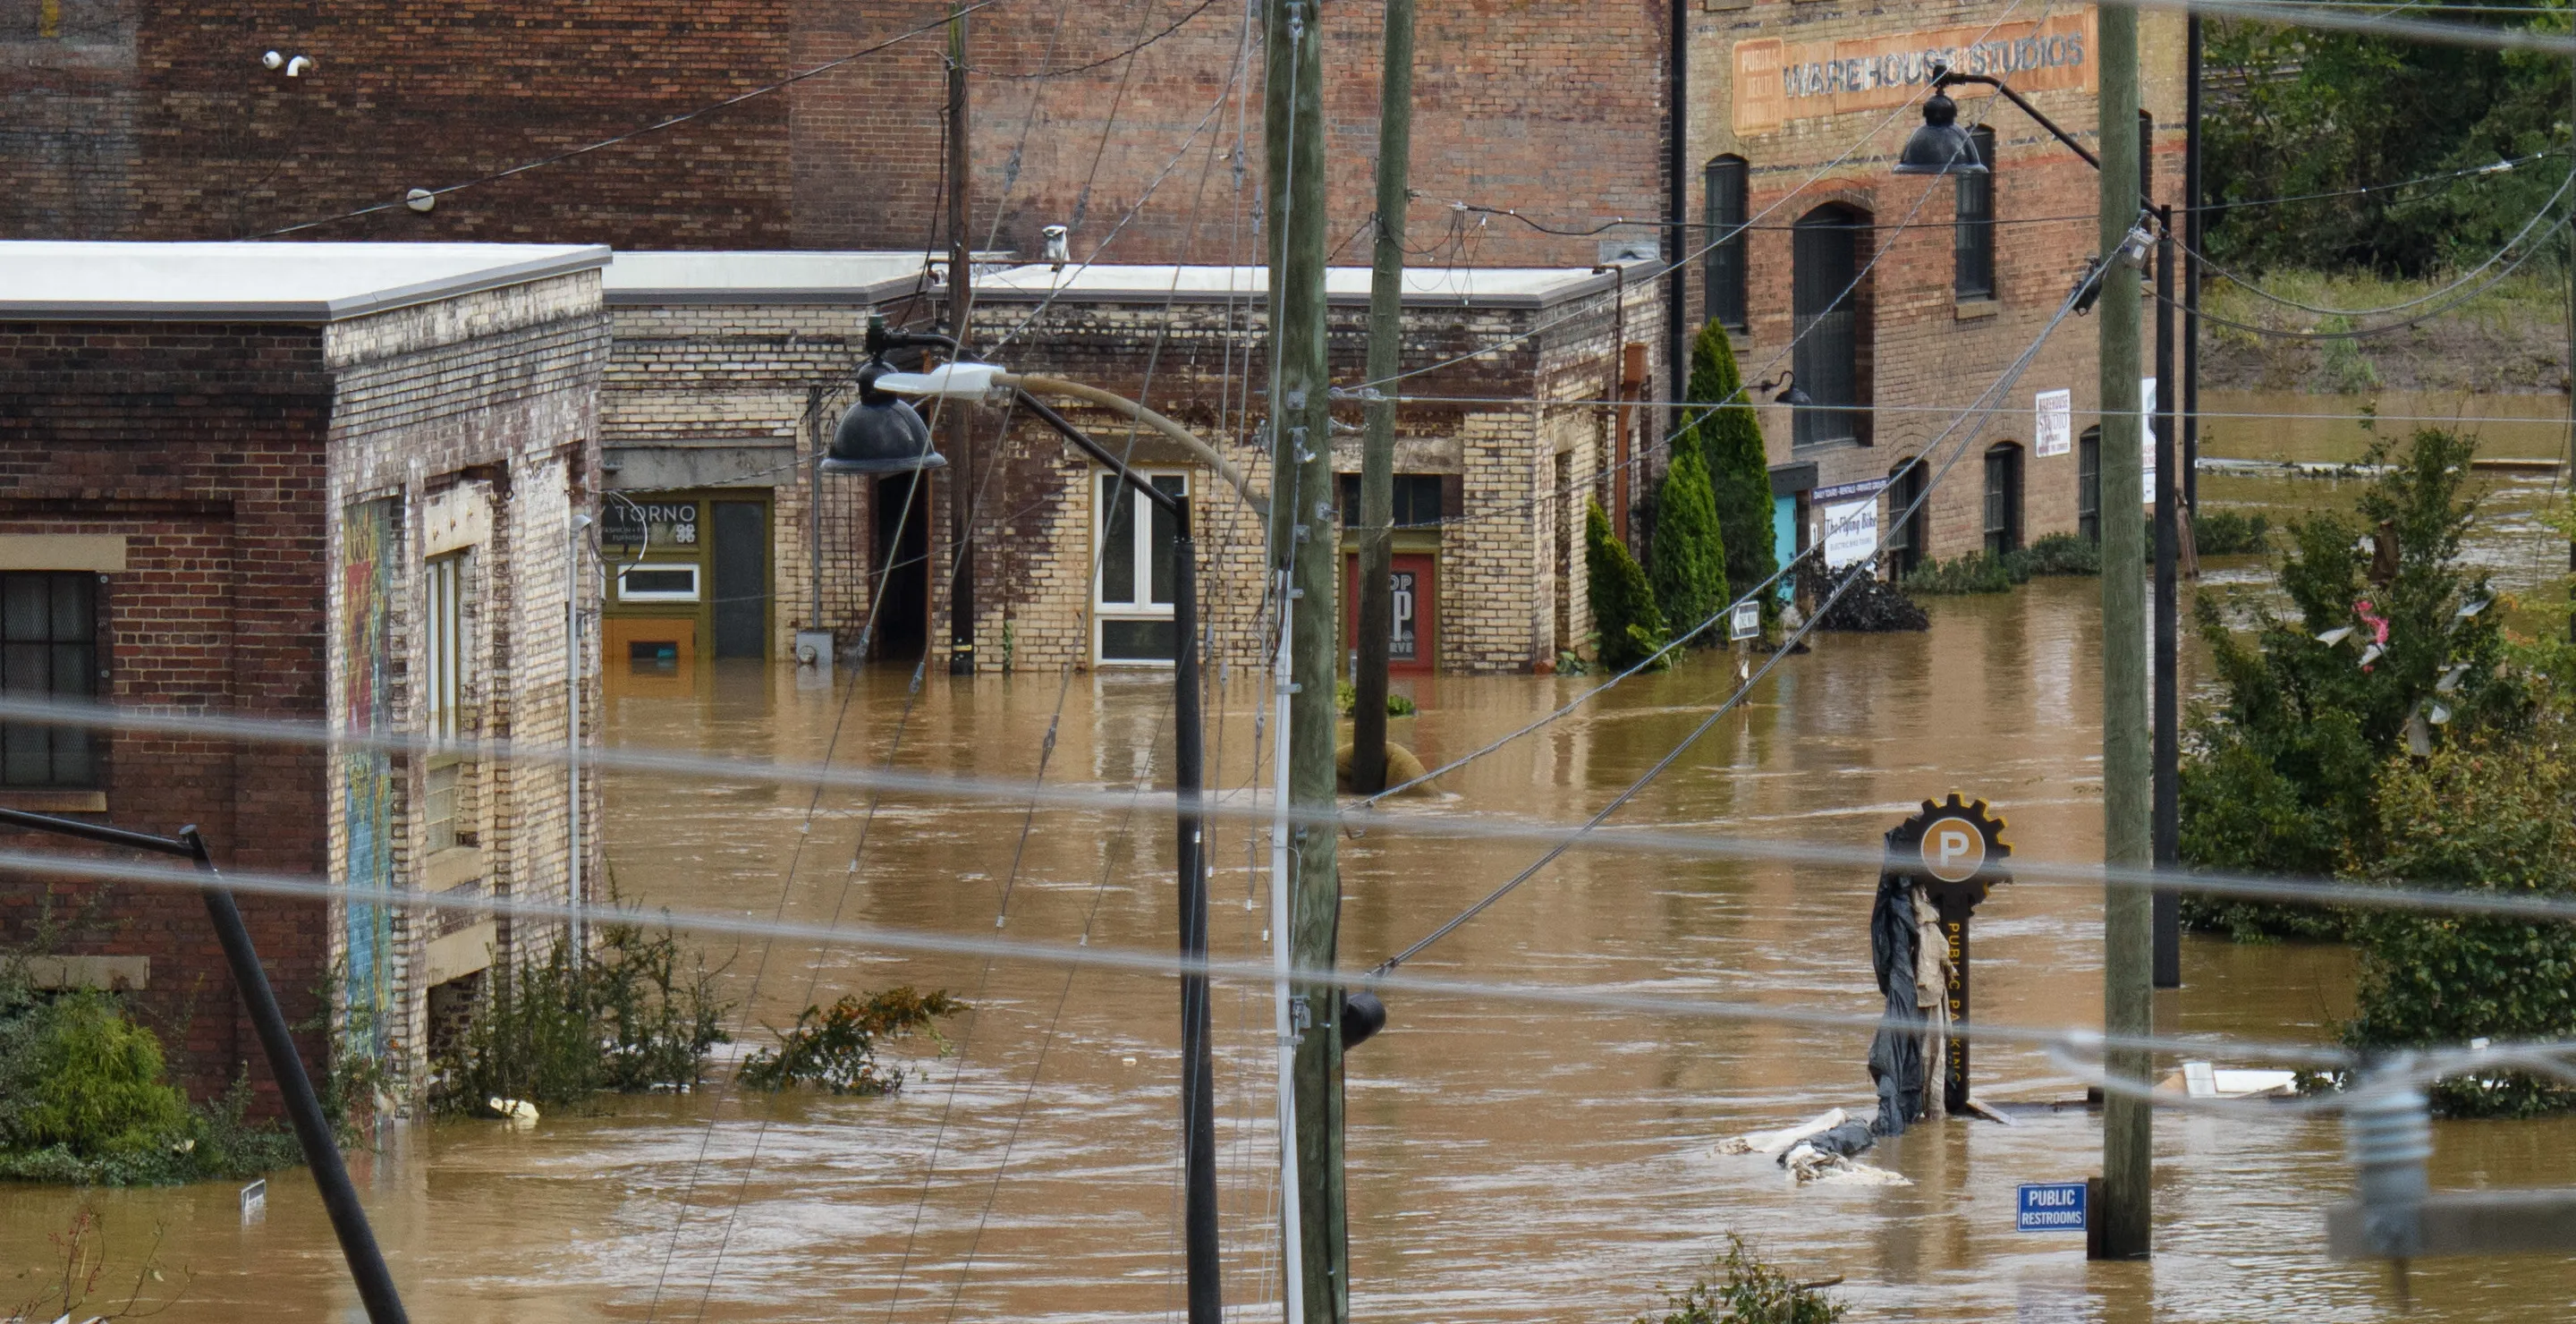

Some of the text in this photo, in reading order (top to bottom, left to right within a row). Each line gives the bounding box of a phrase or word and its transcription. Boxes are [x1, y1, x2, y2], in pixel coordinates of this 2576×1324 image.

[1741, 48, 1778, 73] PURINA
[1970, 30, 2085, 75] STUDIOS
[2038, 412, 2068, 431] STUDIO
[615, 505, 696, 522] TORNO
[1840, 516, 1860, 537] Flying
[1861, 511, 1877, 530] Bike
[1940, 831, 1970, 867] P
[1947, 922, 1961, 990] PUBC
[2029, 1189, 2075, 1207] PUBLIC
[2021, 1210, 2082, 1226] RESTROOMS
